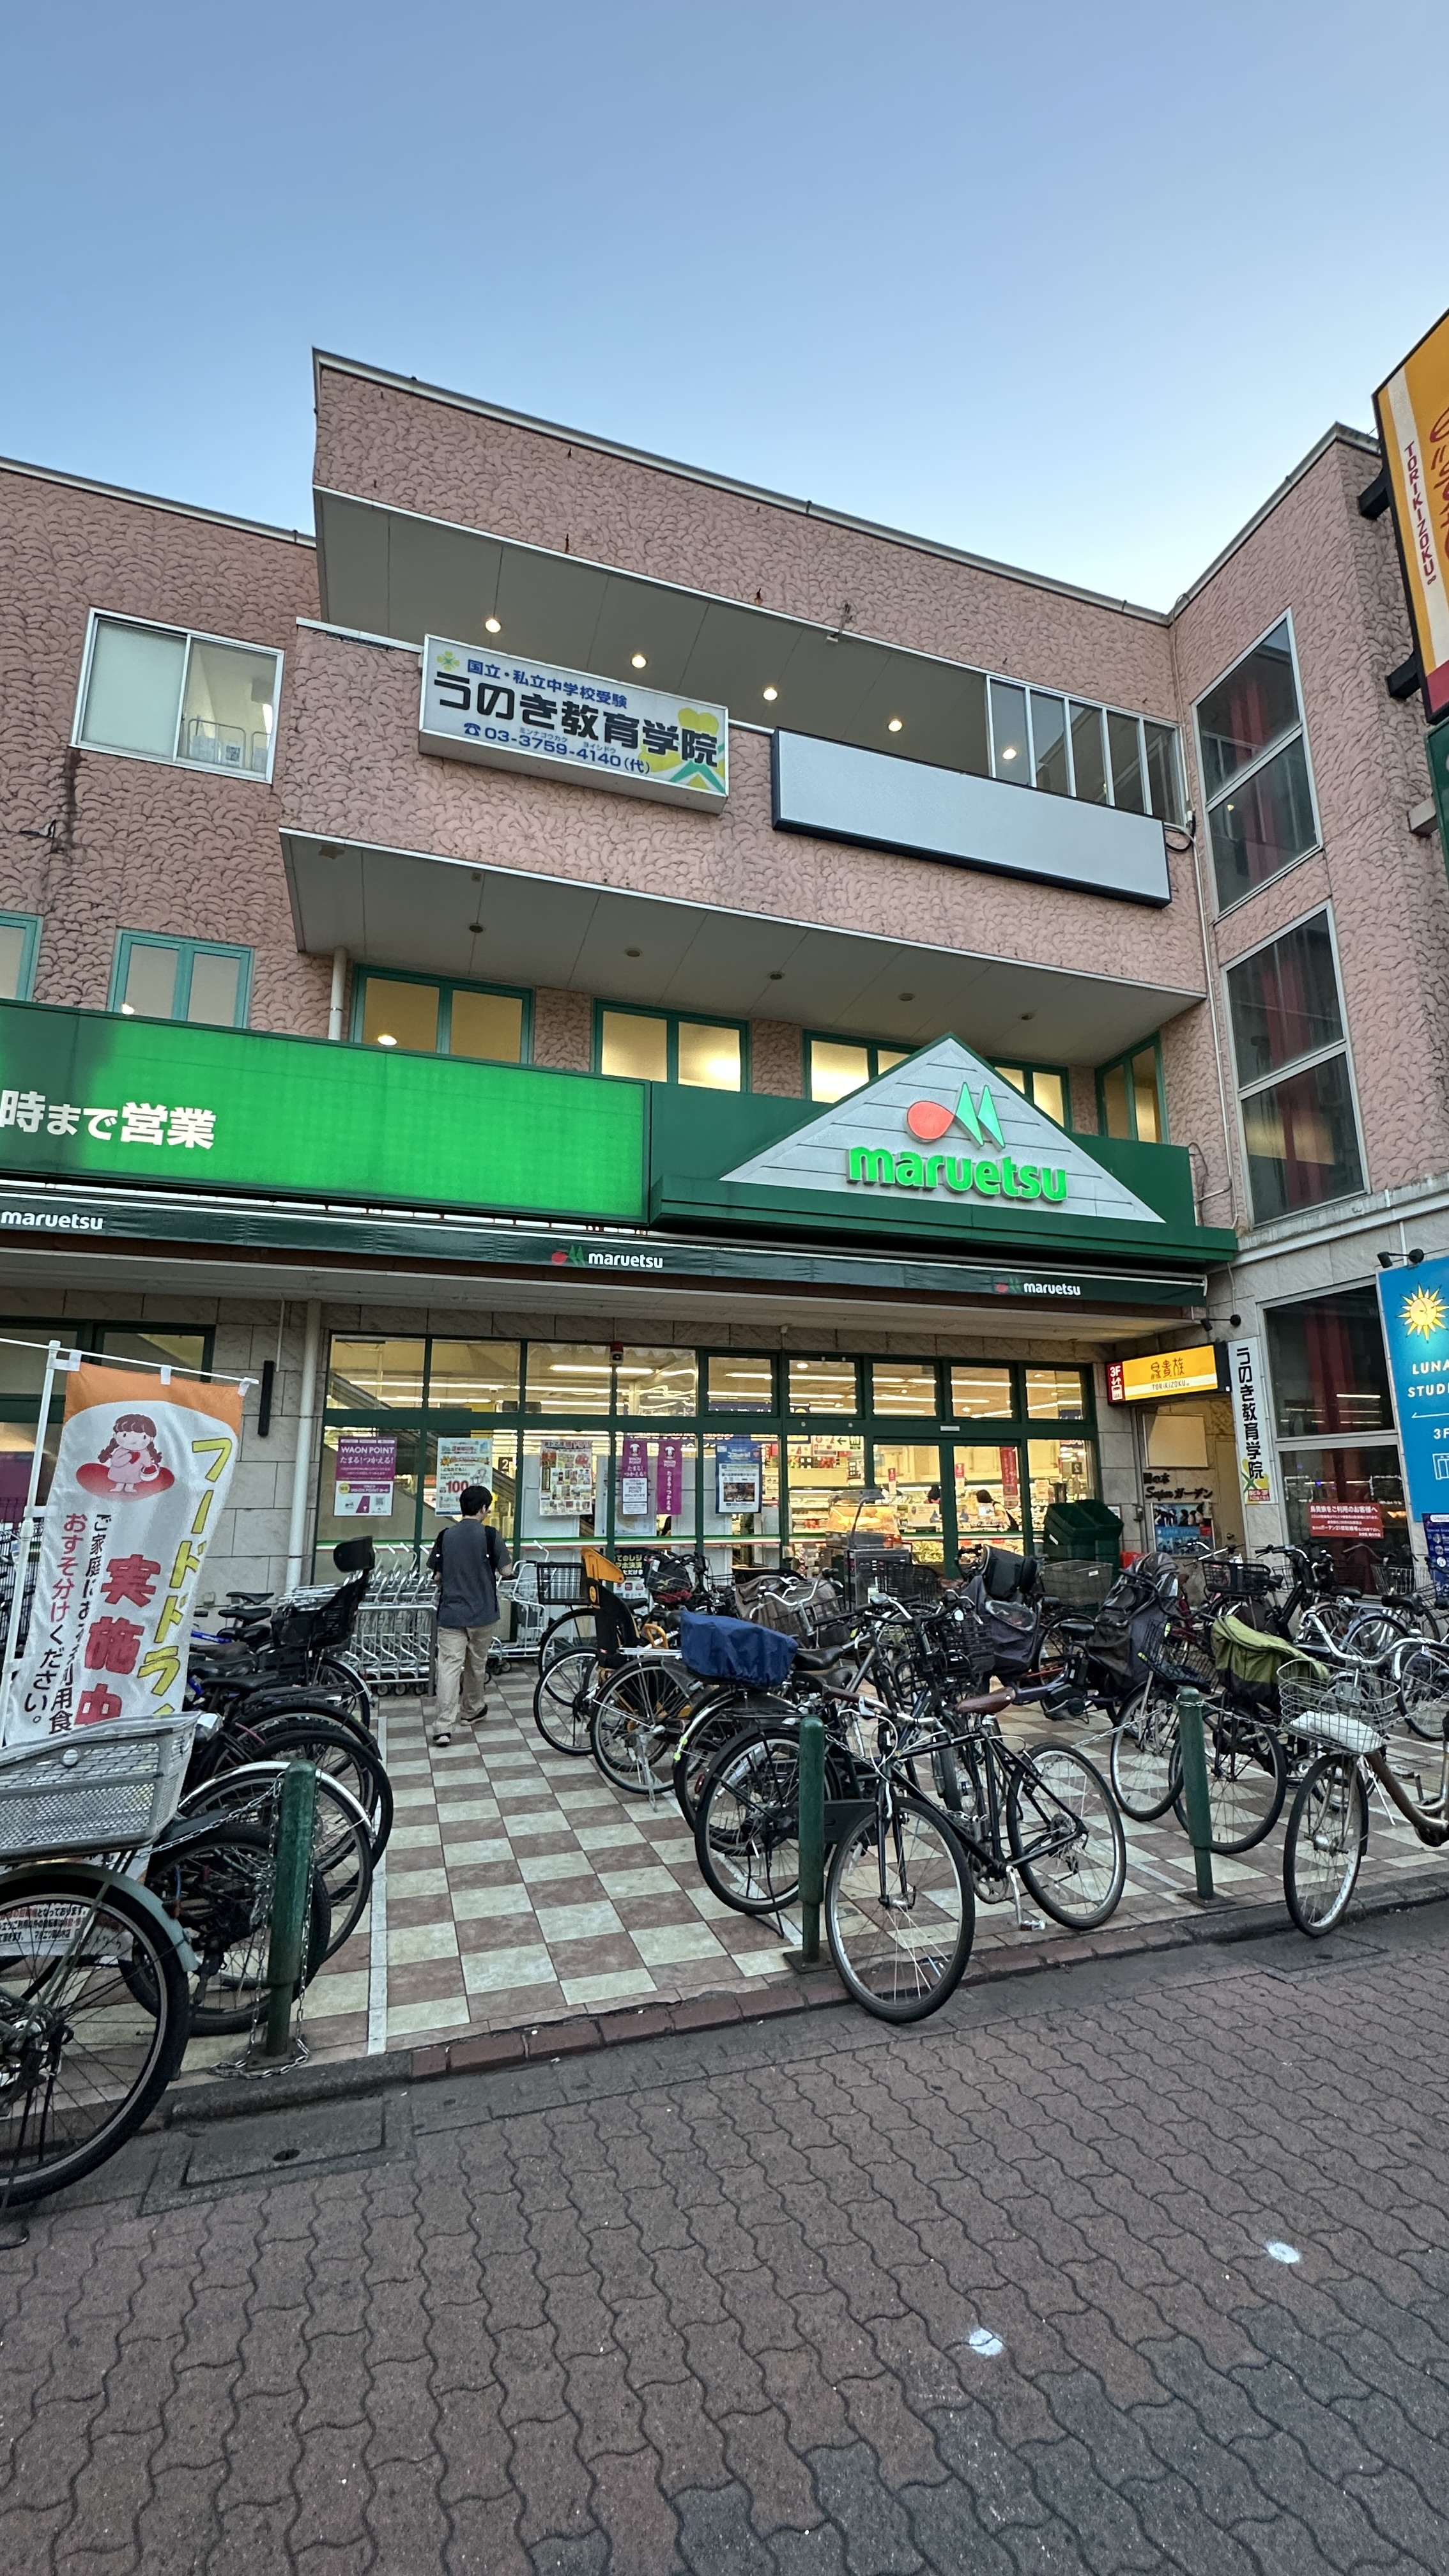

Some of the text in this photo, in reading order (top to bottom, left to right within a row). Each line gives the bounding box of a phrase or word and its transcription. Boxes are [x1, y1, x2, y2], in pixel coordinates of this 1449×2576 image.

[1404, 440, 1435, 576] TORIKIZOKU
[467, 659, 628, 709] 国立・私立中学校受験
[434, 671, 719, 768] うのき教育学院
[0, 1090, 217, 1149] 時まで営業
[847, 1146, 1068, 1202] maruetsu
[1, 1210, 103, 1230] maruetsu
[588, 1252, 663, 1269] maruetsu
[1023, 1281, 1082, 1297] maruetsu
[1110, 1365, 1122, 1377] 3F
[1151, 1379, 1186, 1391] TORIKIZOKU
[1236, 1346, 1264, 1480] うのき教育学院
[502, 1459, 509, 1469] 2
[24, 1512, 88, 1724] おすそ分けください。
[75, 1554, 161, 1726] 実施中
